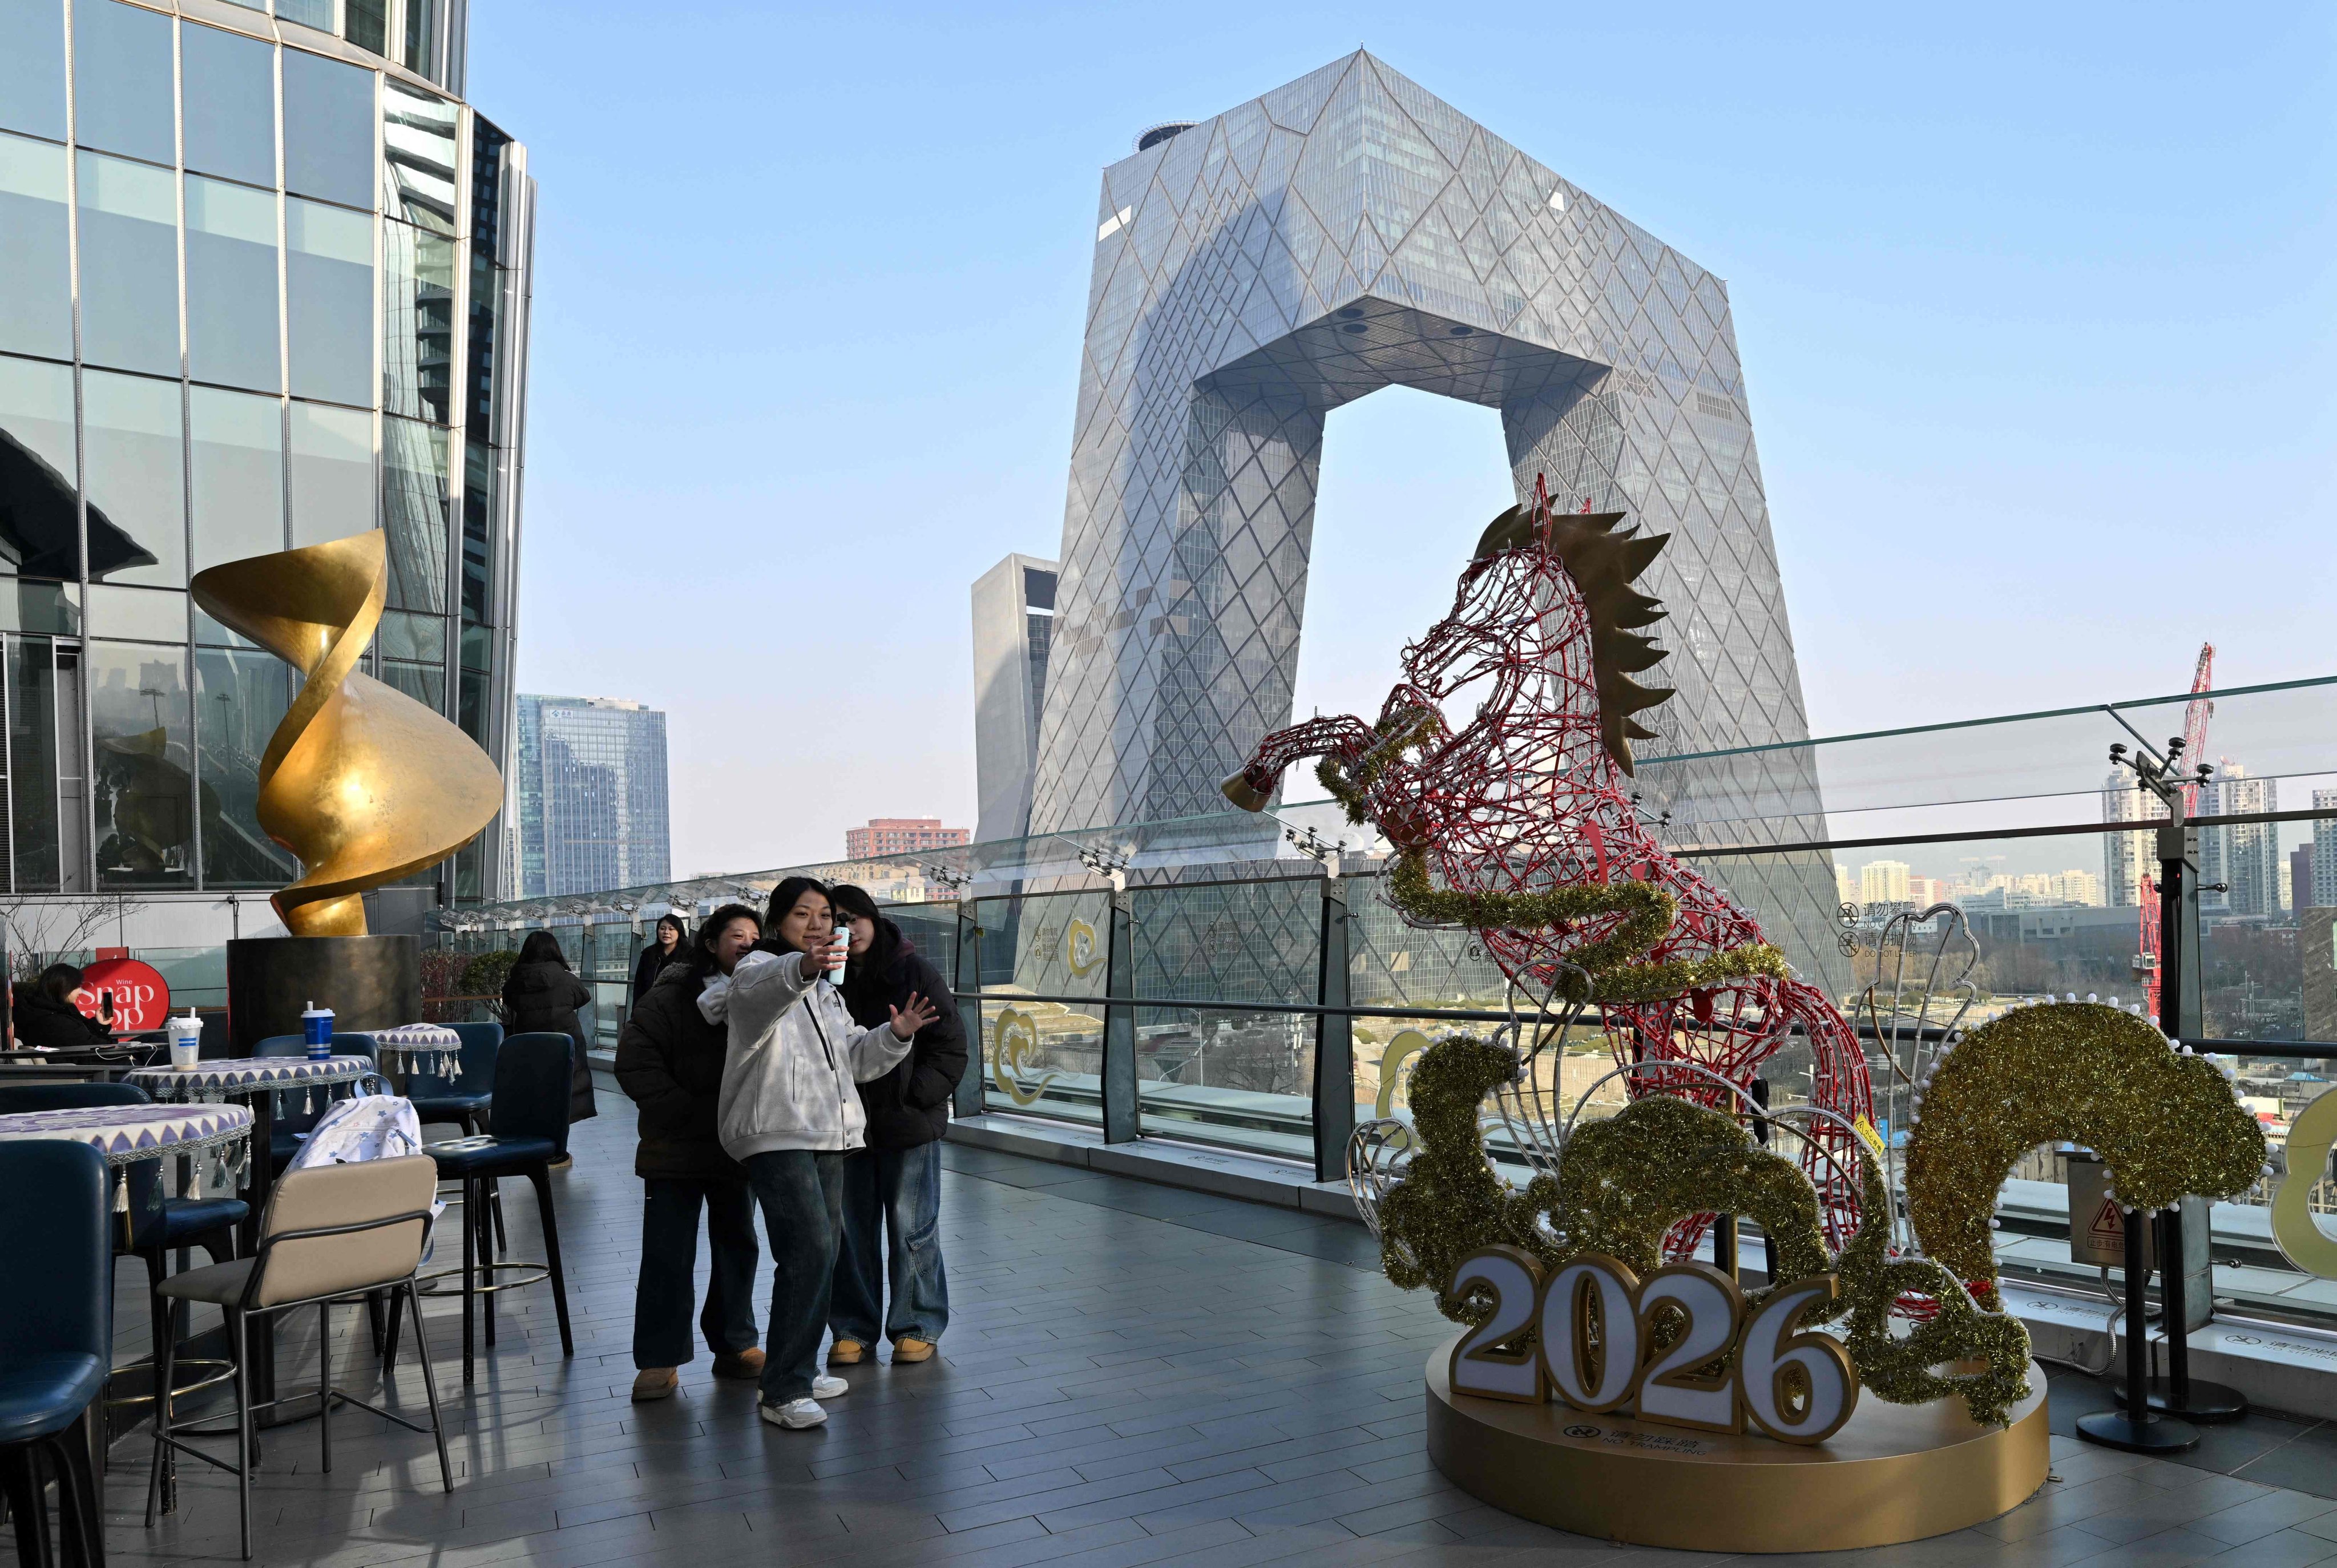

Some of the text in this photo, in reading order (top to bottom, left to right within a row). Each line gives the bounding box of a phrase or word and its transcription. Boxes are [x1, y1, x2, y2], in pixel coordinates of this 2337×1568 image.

[78, 981, 154, 1011] Snap
[1864, 1129, 1882, 1153] 小心有电
[1446, 1243, 1859, 1445] 2026
[1610, 1430, 1701, 1448] 请勿踩踏
[1629, 1441, 1708, 1456] TRAMPLING
